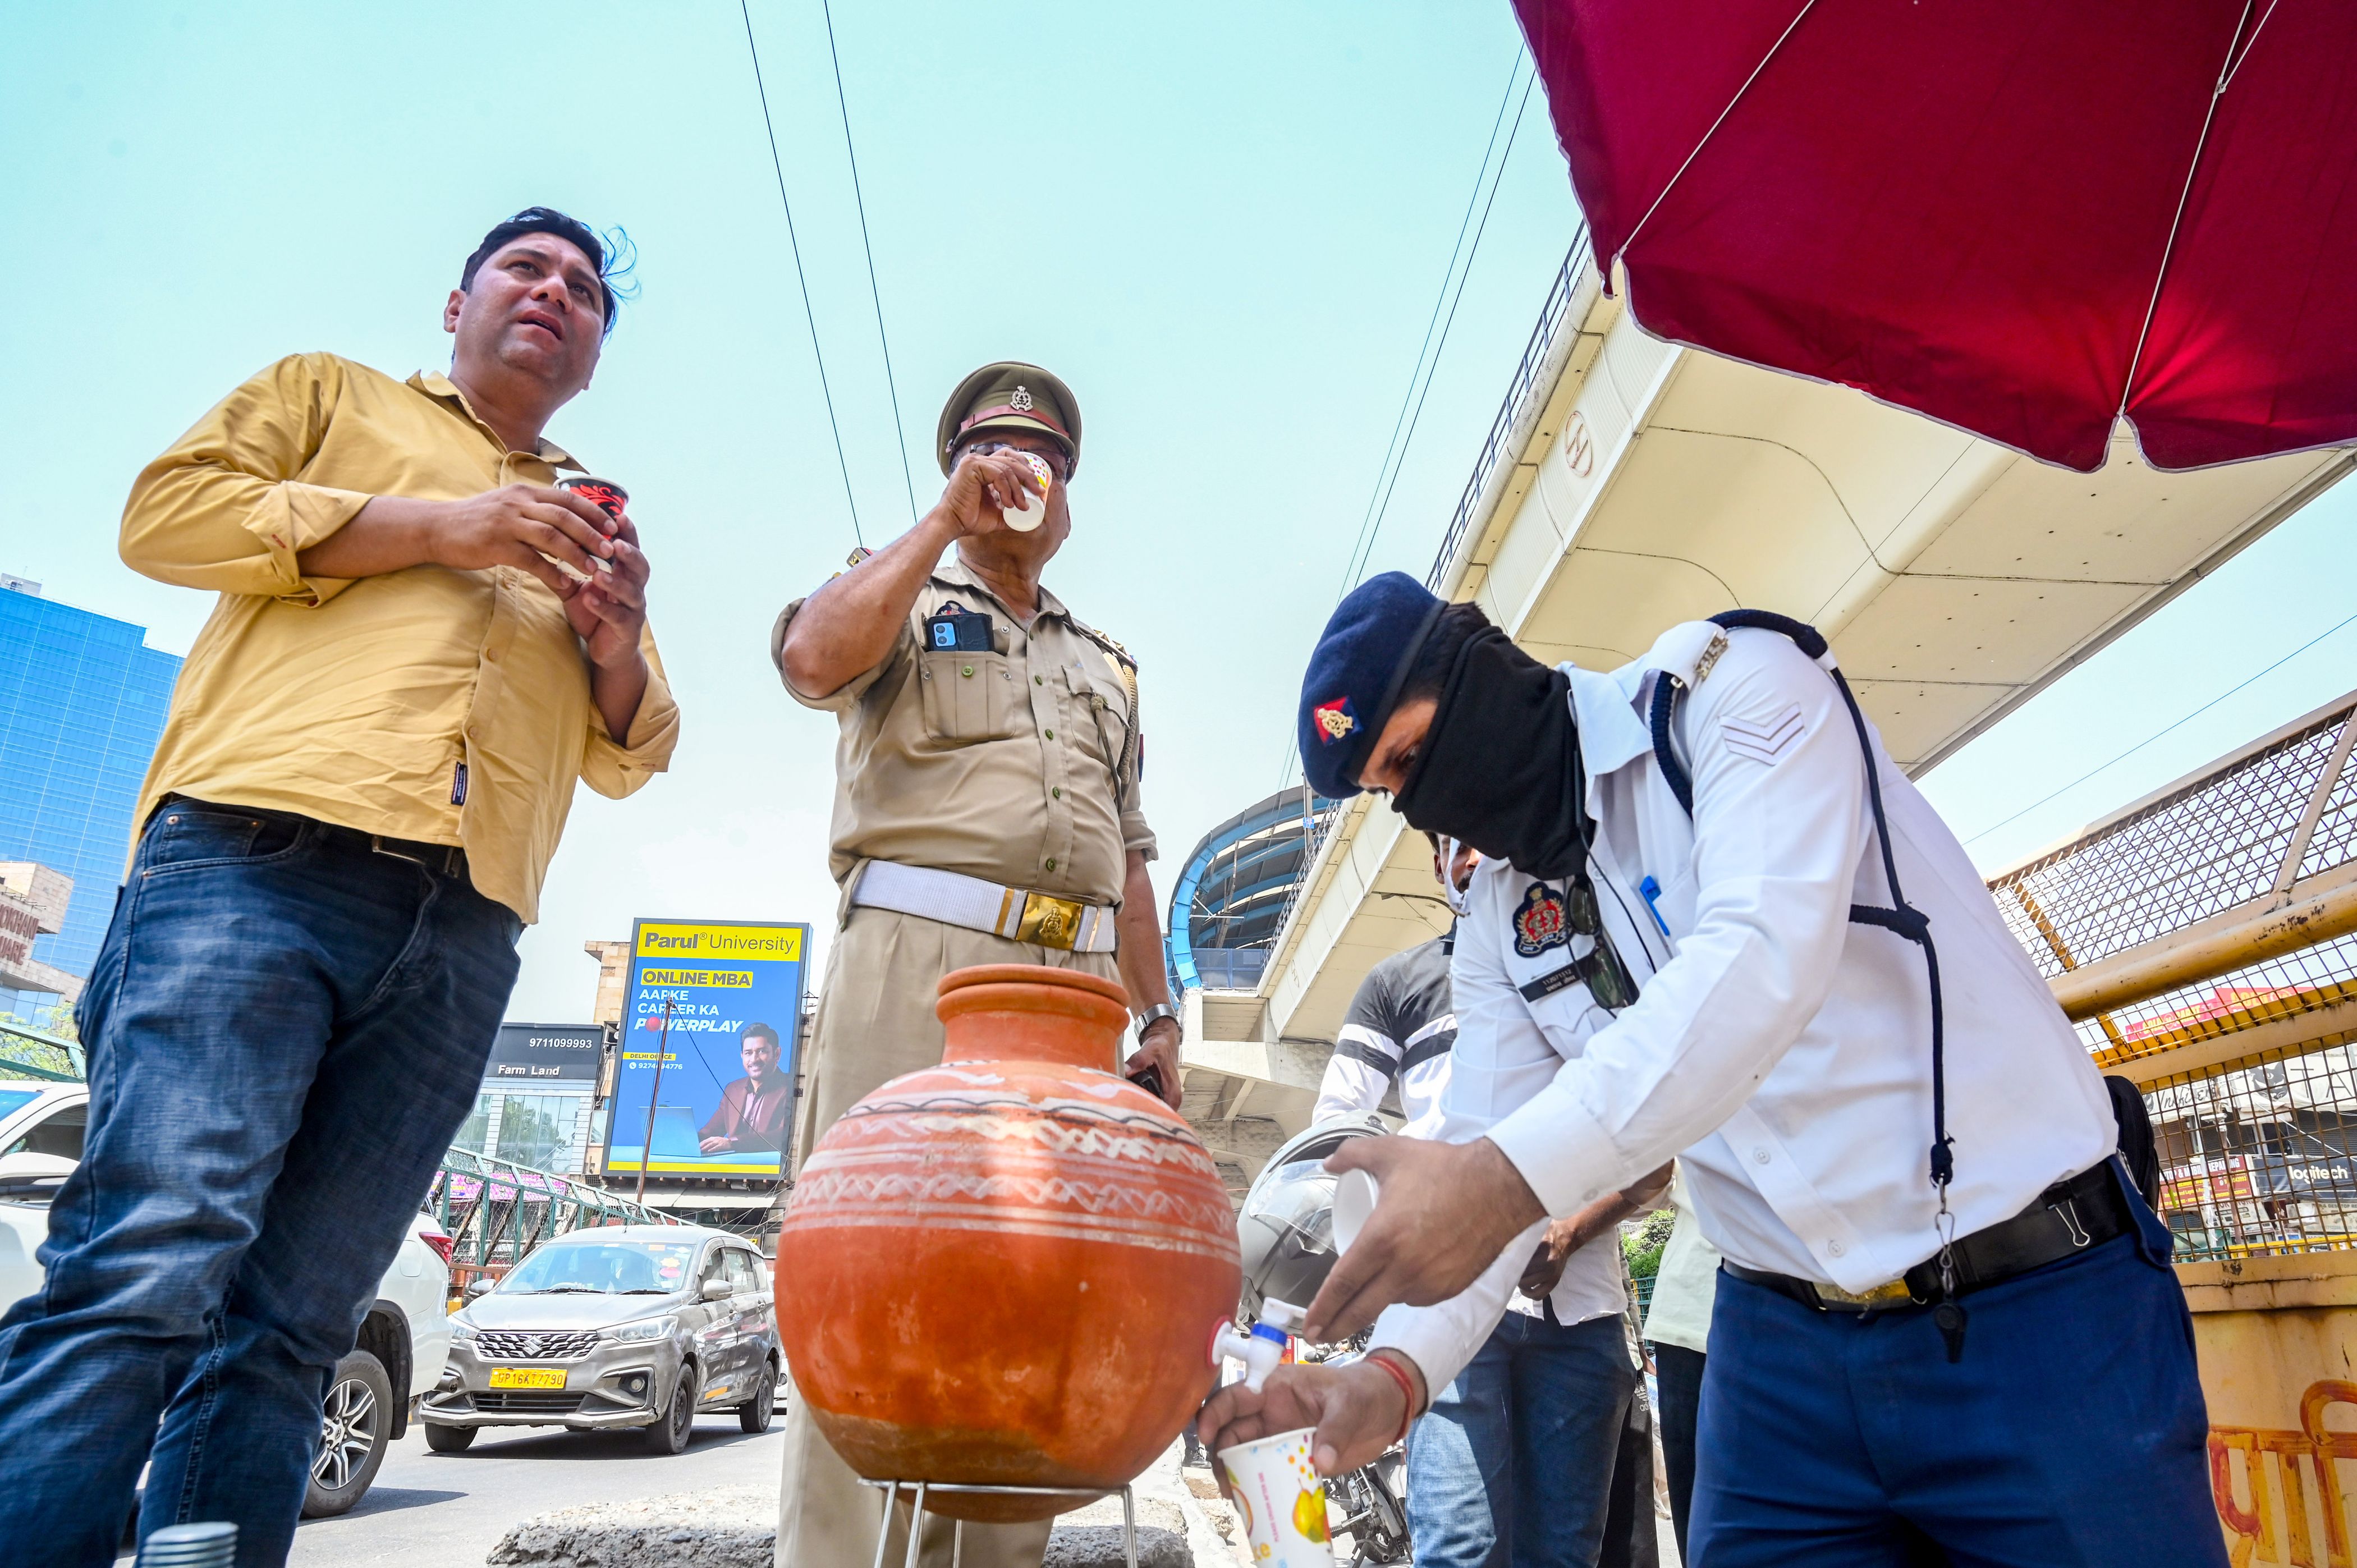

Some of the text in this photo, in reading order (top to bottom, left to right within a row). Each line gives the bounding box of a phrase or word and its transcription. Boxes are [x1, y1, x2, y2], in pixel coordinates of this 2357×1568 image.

[710, 934, 795, 955] University
[643, 970, 751, 986] ONLINE MBA
[639, 989, 689, 1001] AAPKE
[699, 1005, 719, 1015] KA
[529, 1038, 593, 1049] 9711099993
[498, 1065, 560, 1076] Farm Land
[2178, 1169, 2184, 1178] &
[2208, 1158, 2240, 1172] REPAIING
[2289, 1165, 2348, 1184] logitech
